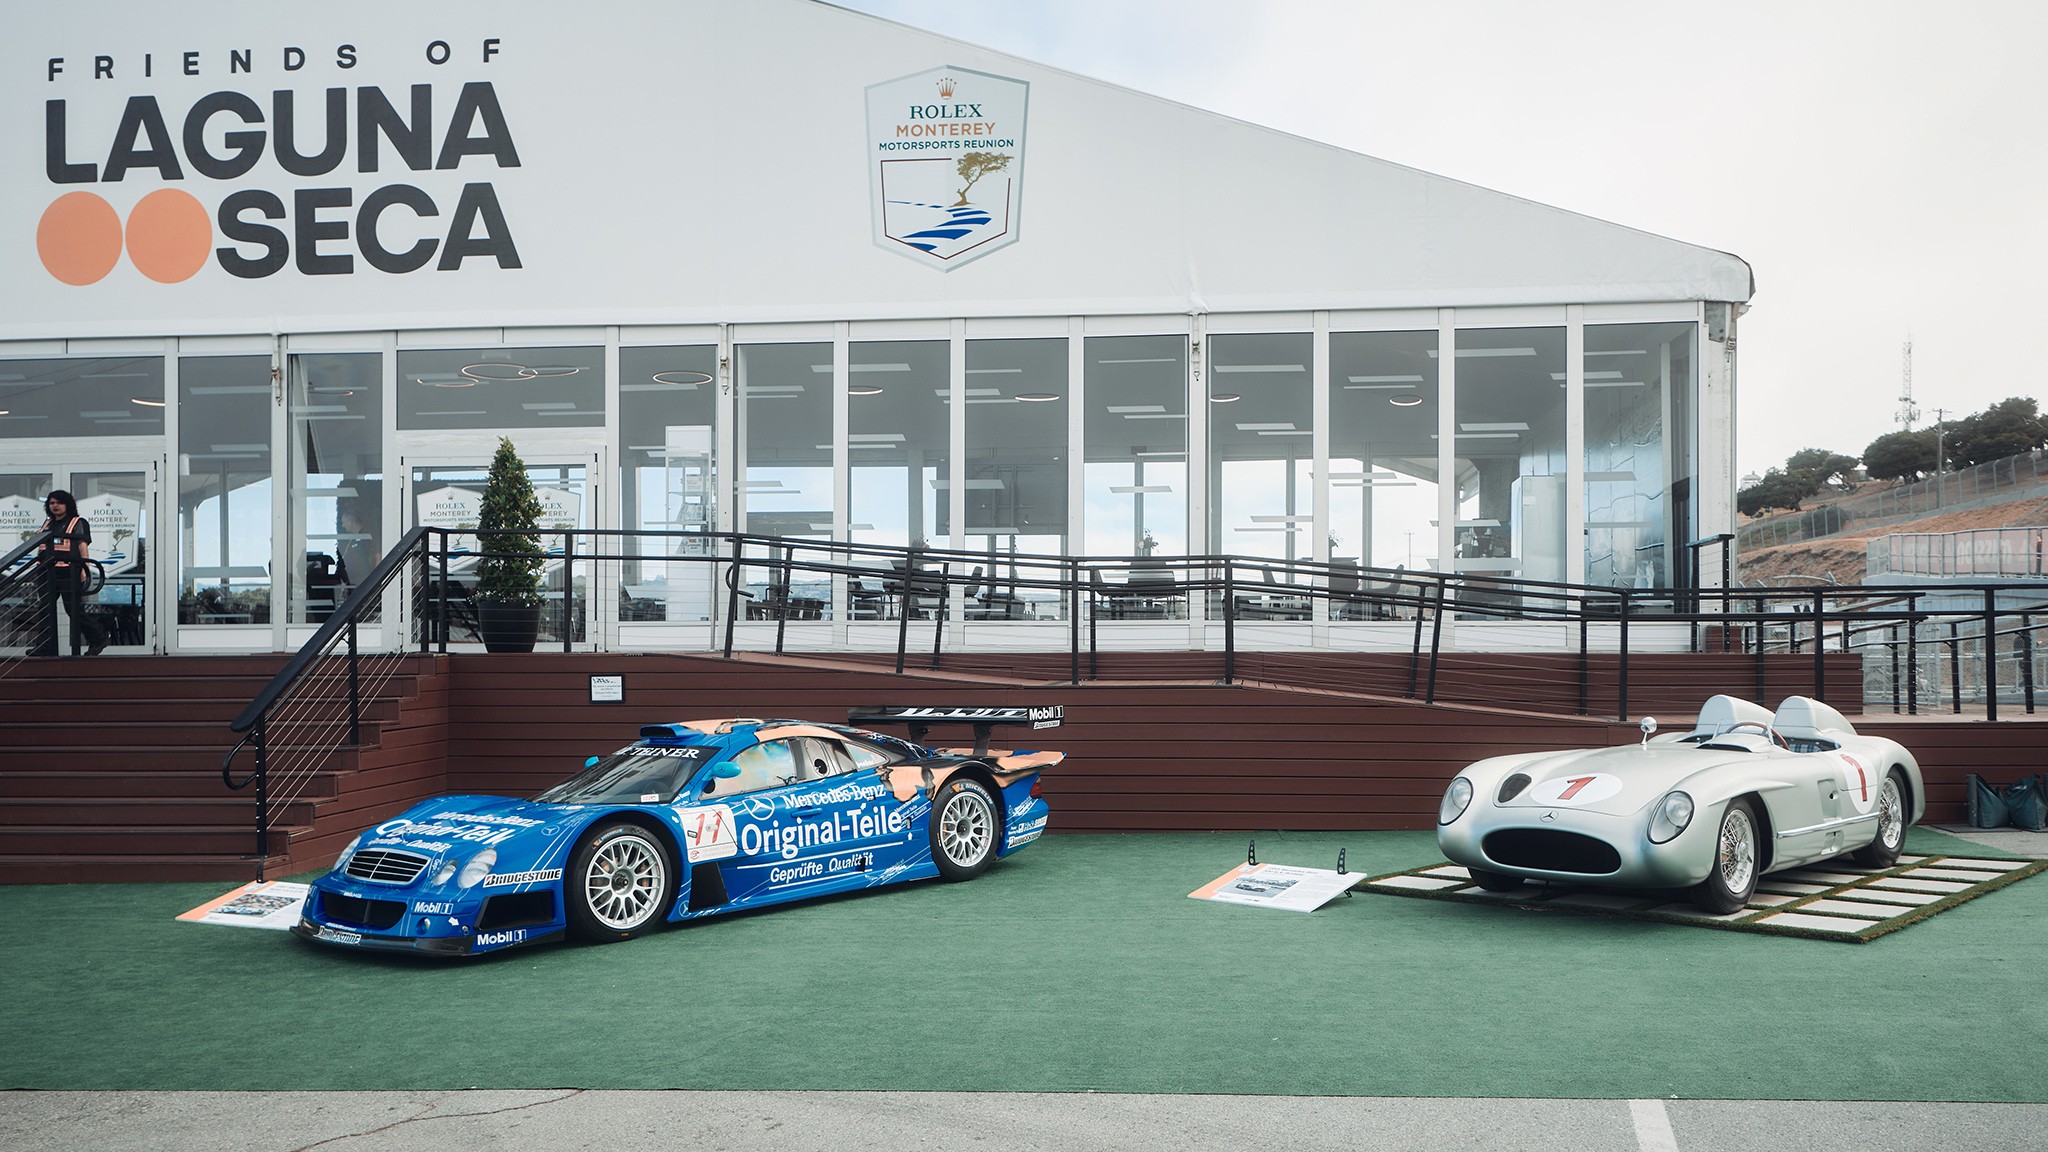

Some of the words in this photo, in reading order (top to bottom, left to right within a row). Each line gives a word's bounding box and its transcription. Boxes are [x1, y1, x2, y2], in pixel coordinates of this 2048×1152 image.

[48, 44, 357, 81] FRIENDS
[426, 38, 500, 65] OF
[909, 104, 983, 119] ROLEX
[46, 81, 521, 184] LAGUNA
[896, 122, 996, 137] MONTEREY
[879, 140, 960, 151] MOTORSPORTS
[964, 139, 1014, 148] REUNION
[216, 182, 522, 279] SECA
[1029, 706, 1054, 720] Mobil
[1557, 776, 1596, 800] 1
[1840, 754, 1867, 802] 1
[784, 784, 886, 809] Mercedes-Benz
[965, 783, 993, 804] MICHELIN
[695, 810, 723, 846] 11
[742, 805, 901, 859] Original-Teile
[485, 869, 561, 886] BRIDGESTONE
[770, 861, 823, 884] Geprüfte
[828, 852, 874, 872] Qualität
[414, 902, 441, 913] Mobil
[477, 930, 513, 946] Mobil
